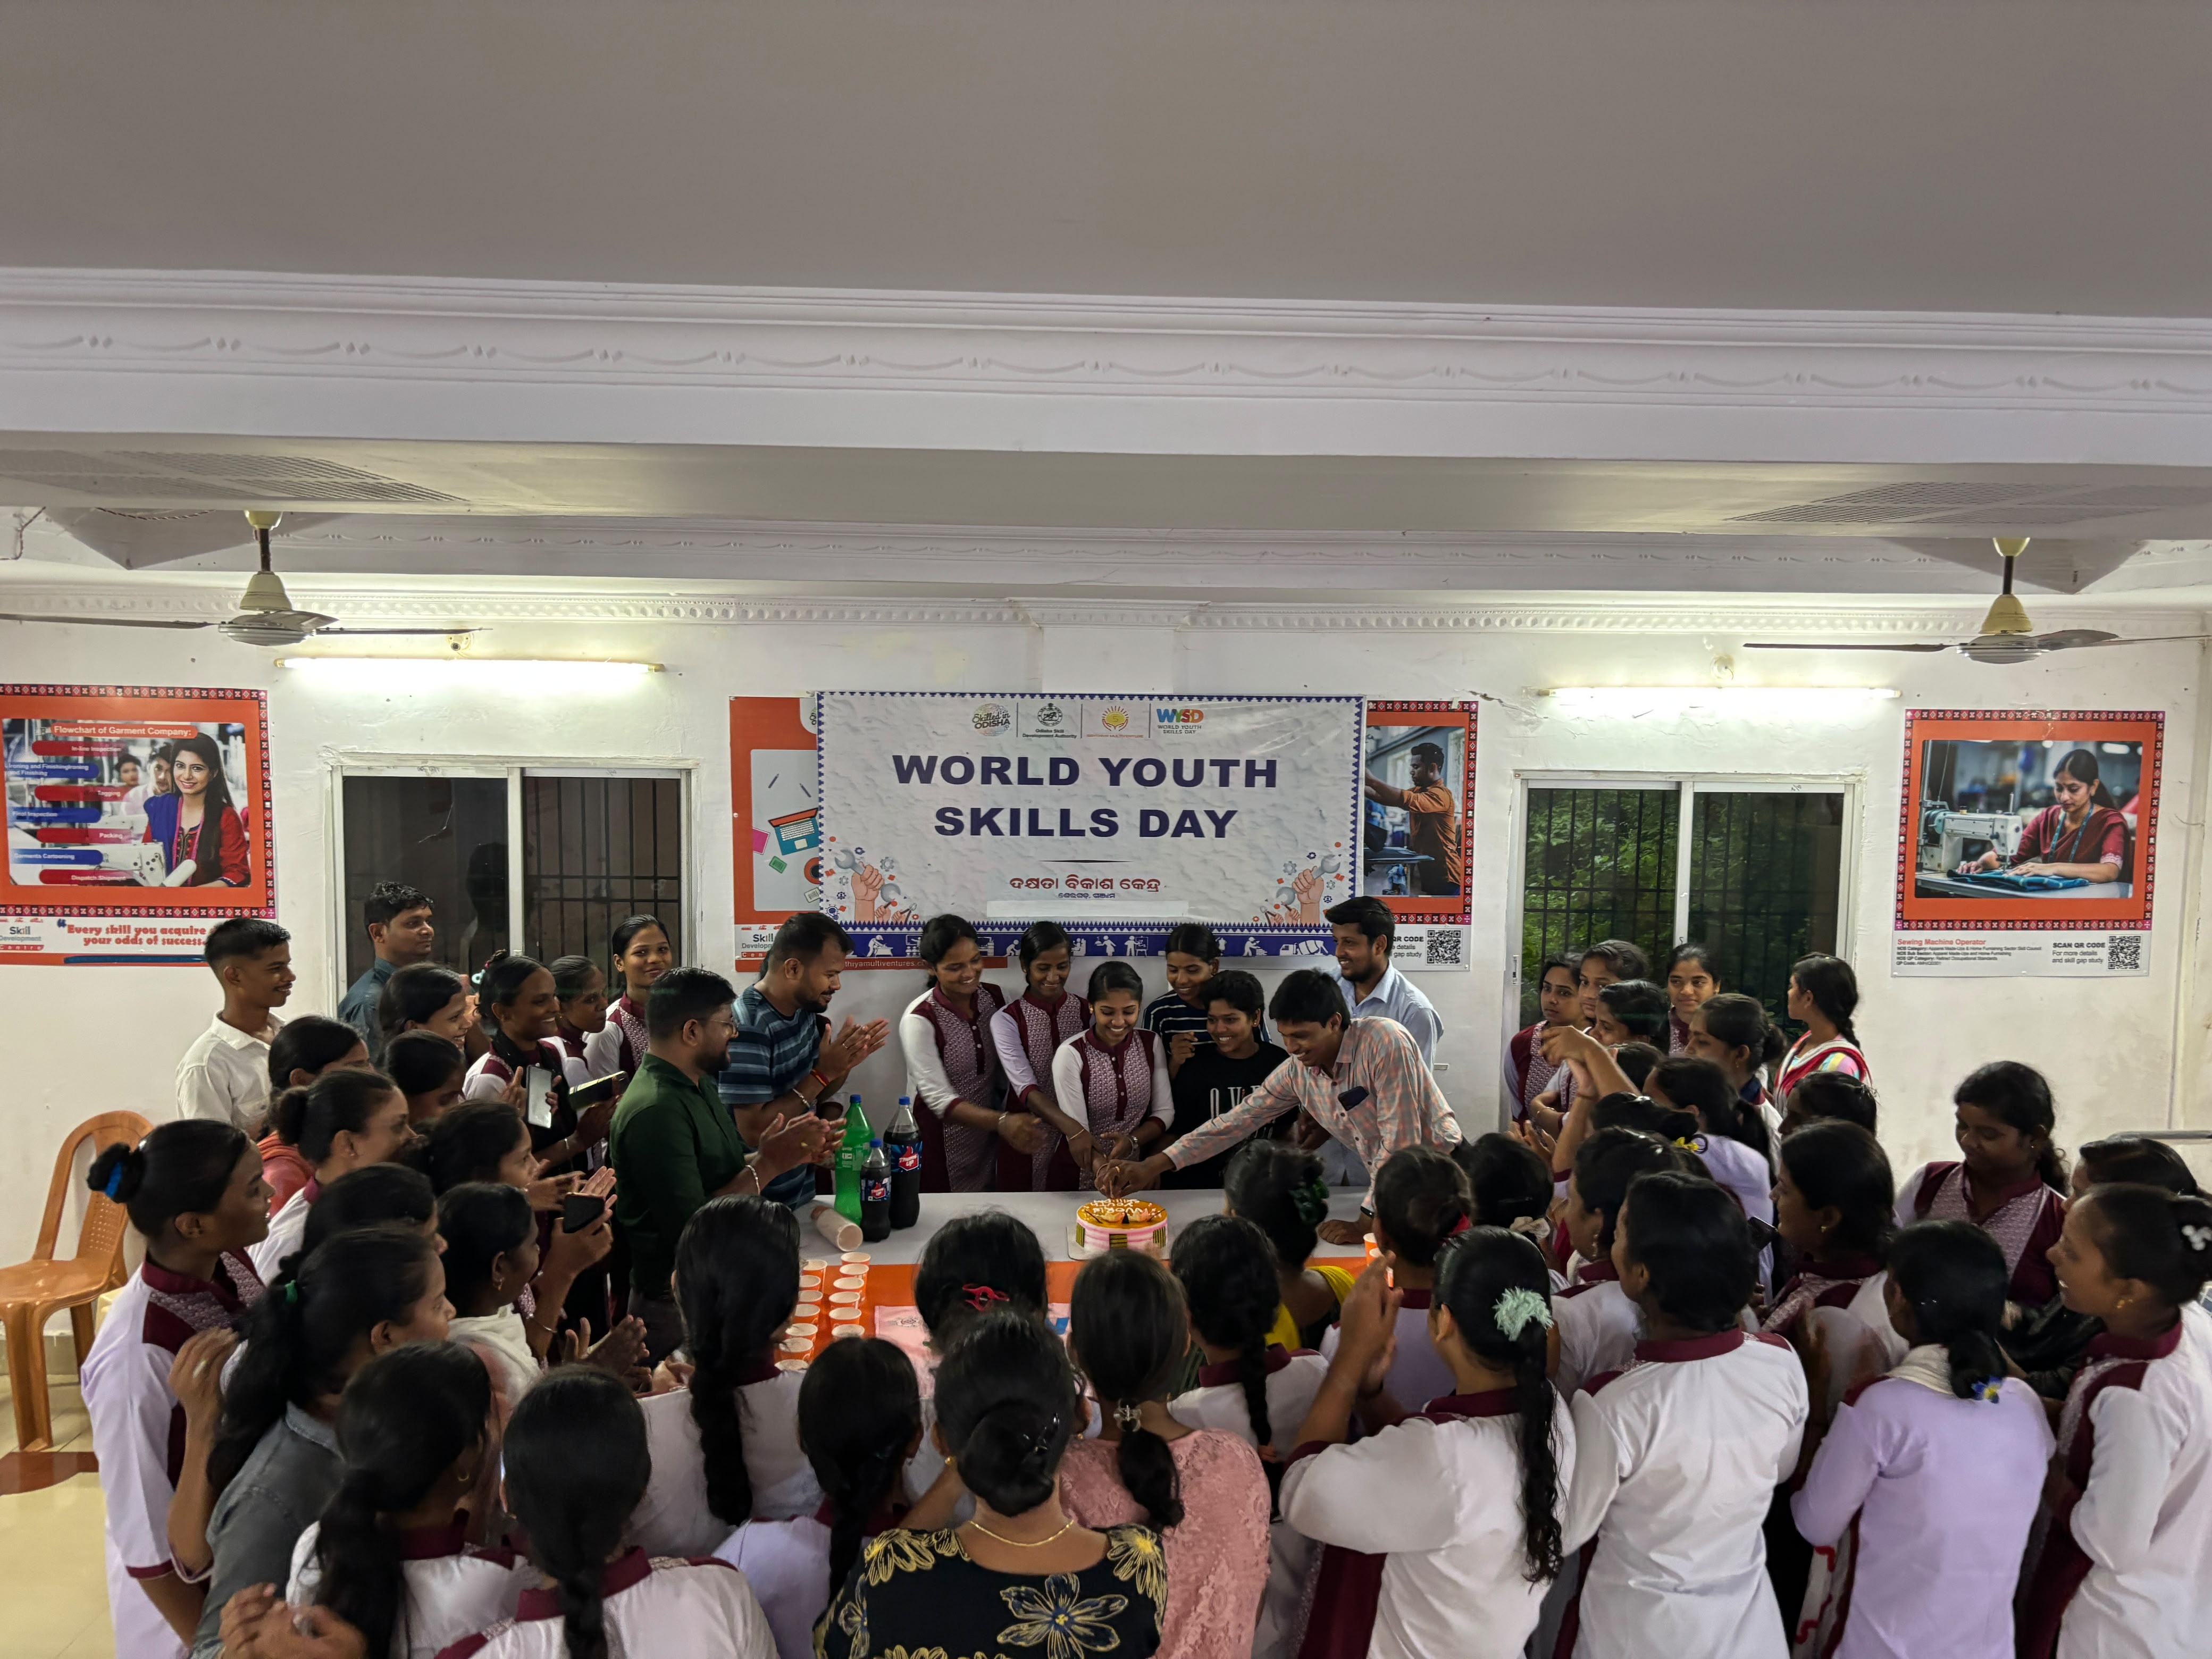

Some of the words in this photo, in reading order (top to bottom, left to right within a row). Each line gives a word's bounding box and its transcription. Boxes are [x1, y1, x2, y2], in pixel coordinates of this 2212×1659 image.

[972, 711, 1001, 723] Skilled
[1157, 709, 1204, 723] WYSD
[975, 718, 1010, 729] ODISHA
[147, 728, 191, 736] Company:
[893, 755, 1080, 786] WORLD
[1098, 757, 1277, 787] YOUTH
[934, 807, 1119, 837] SKILLS
[1139, 809, 1238, 838] DAY
[106, 925, 131, 934] skill
[134, 927, 157, 936] you
[160, 925, 206, 936] acquire
[83, 937, 112, 946] your
[115, 935, 143, 945] odds
[146, 935, 158, 945] of
[753, 933, 773, 942] Skill
